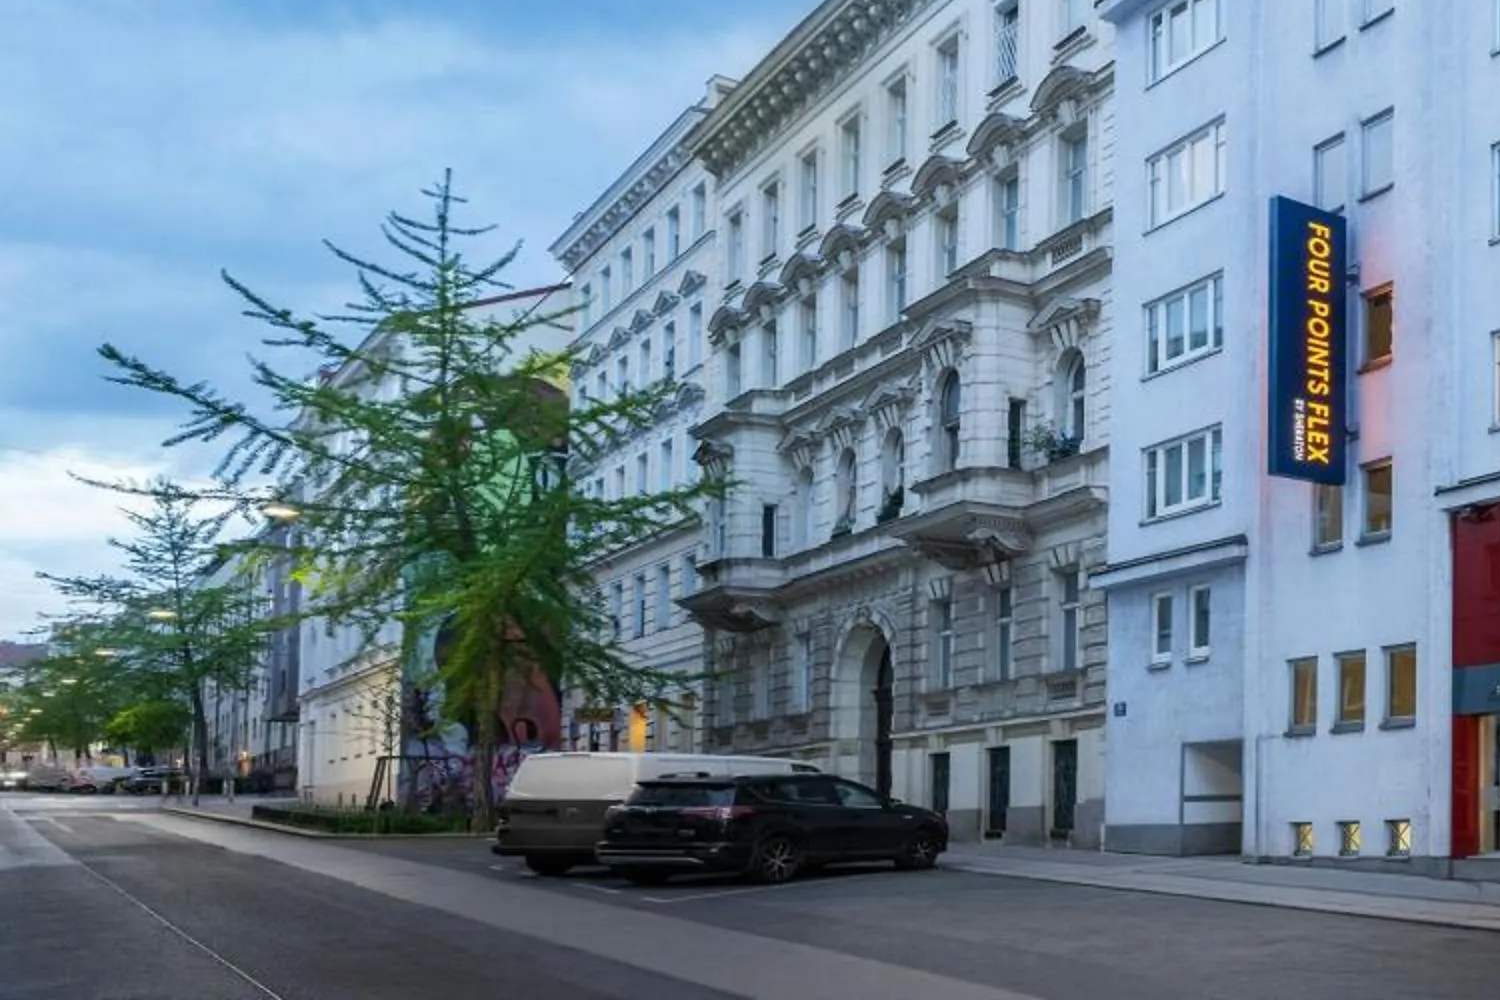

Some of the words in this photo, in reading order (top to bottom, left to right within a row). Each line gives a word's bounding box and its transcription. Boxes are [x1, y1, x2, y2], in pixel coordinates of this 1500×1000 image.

[1307, 222, 1330, 293] FOUR
[1307, 299, 1330, 396] POINTS
[1307, 402, 1329, 464] FLEX
